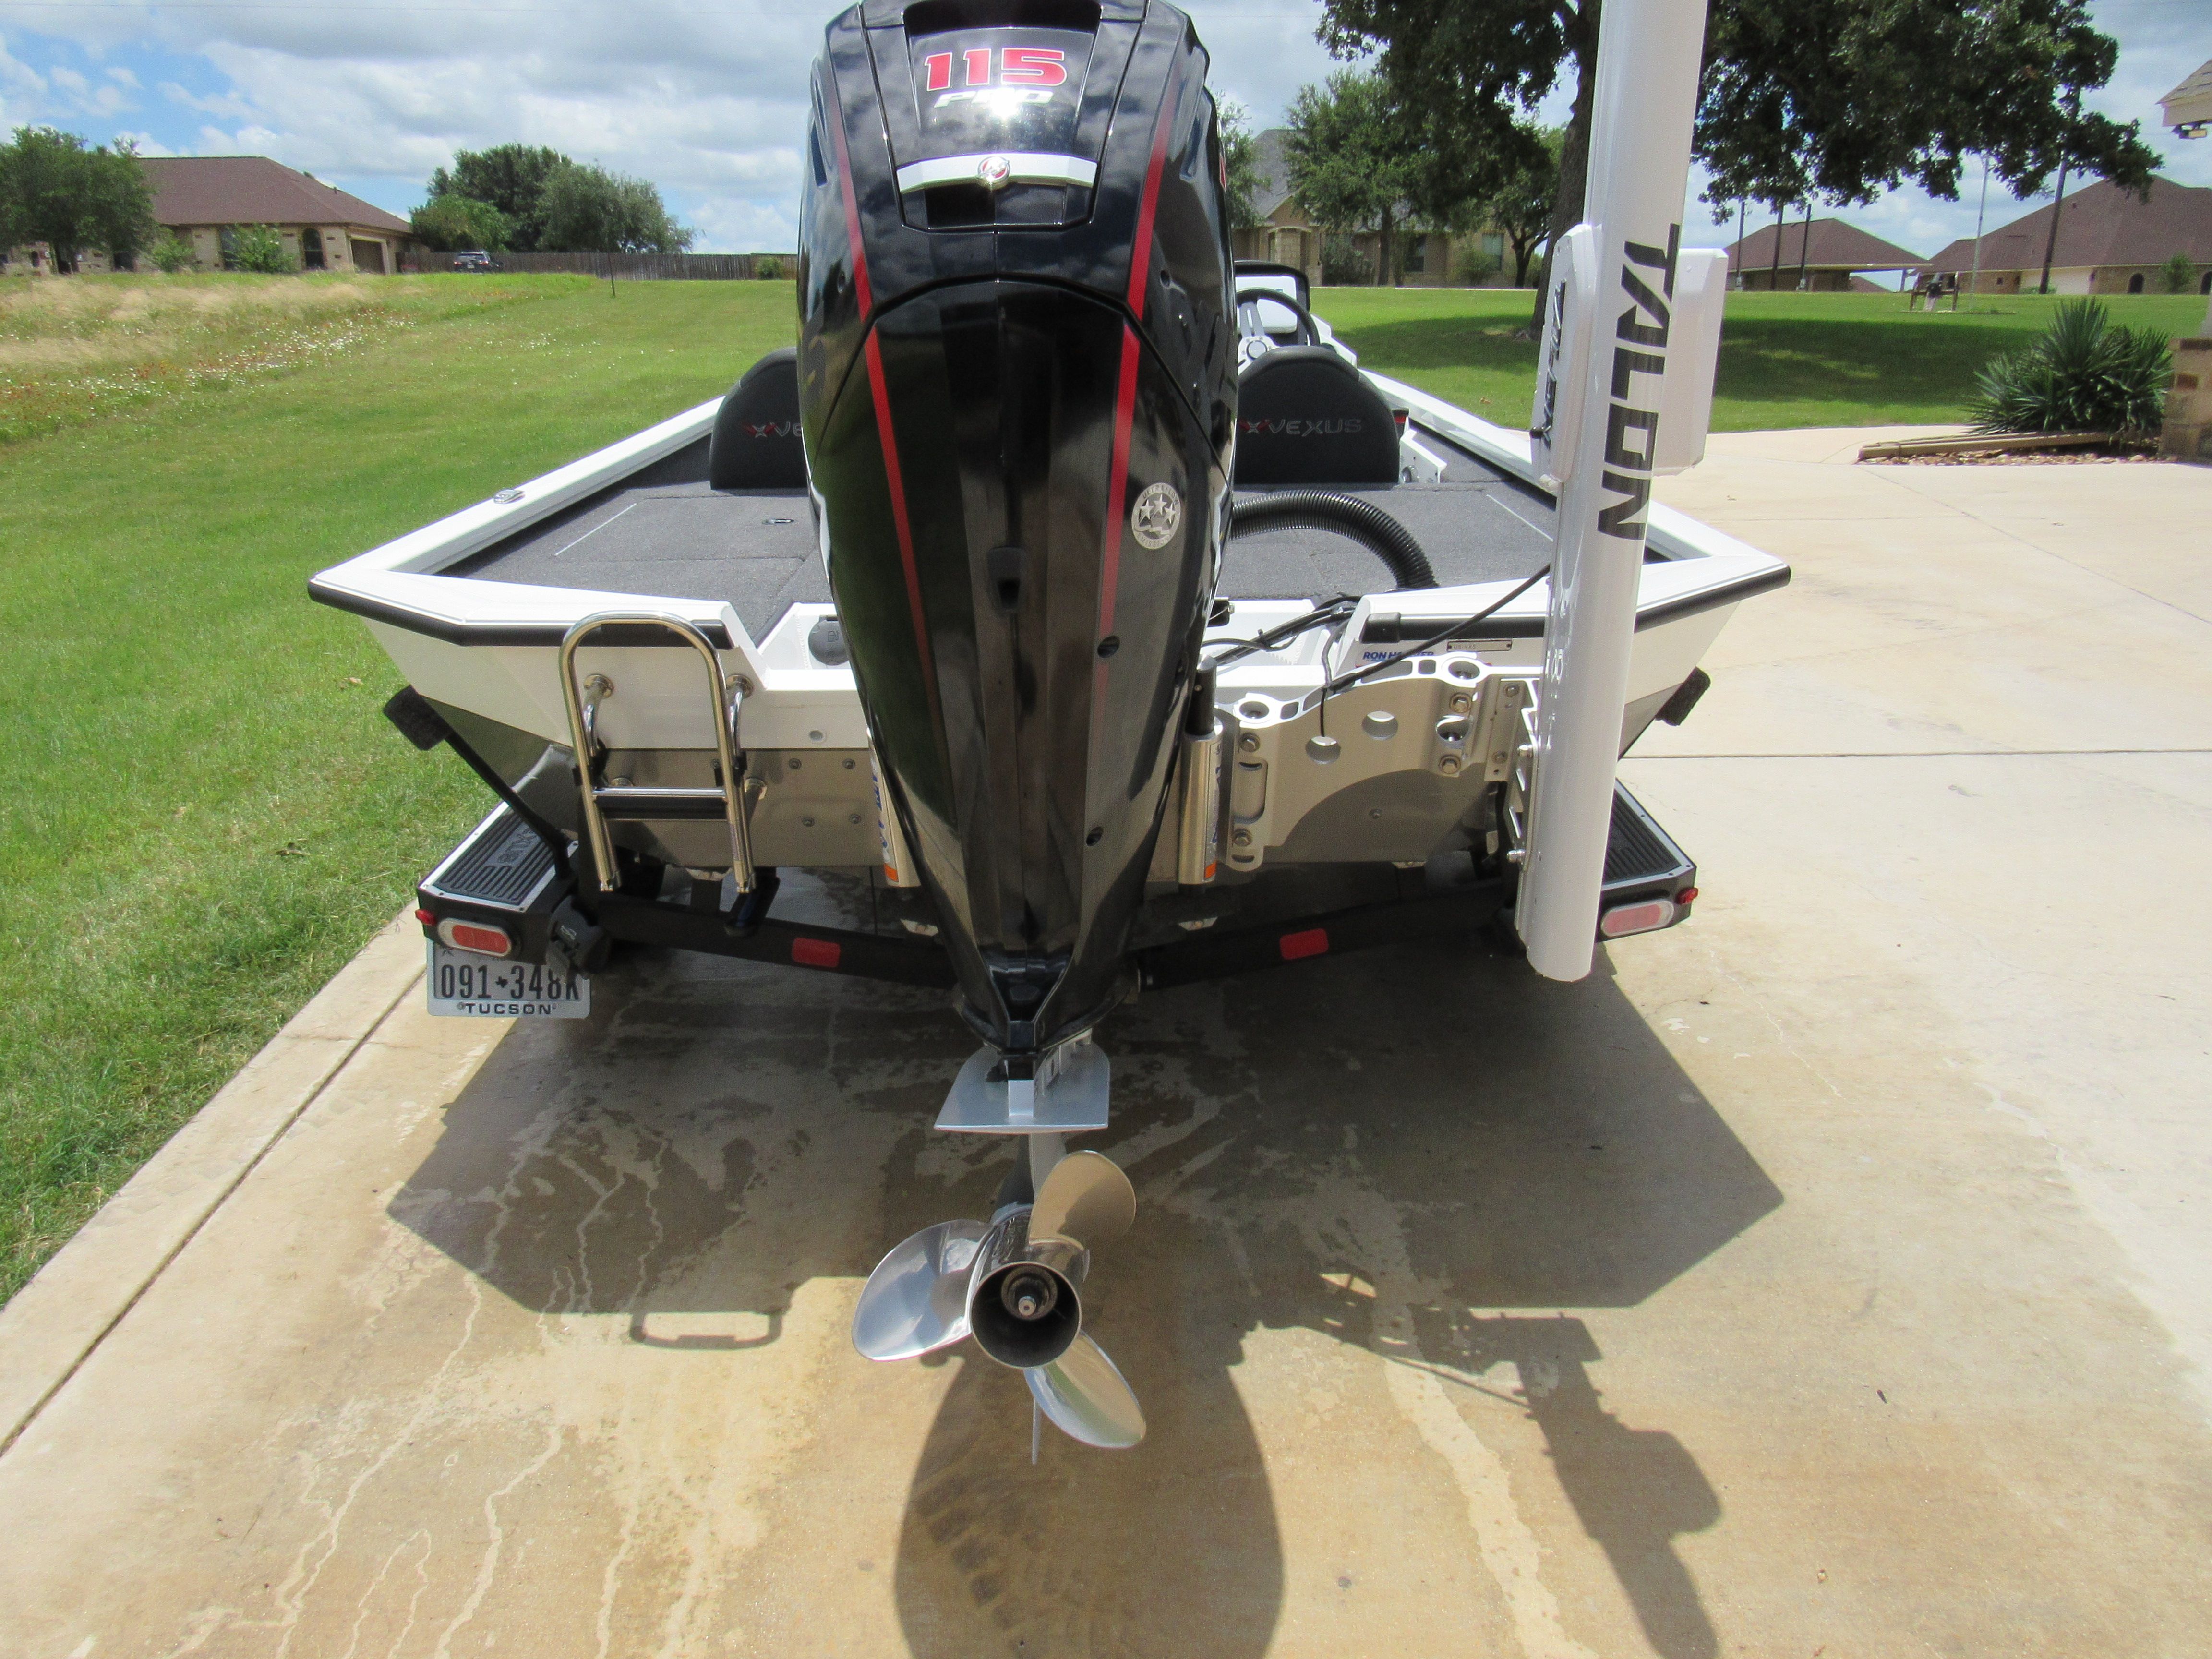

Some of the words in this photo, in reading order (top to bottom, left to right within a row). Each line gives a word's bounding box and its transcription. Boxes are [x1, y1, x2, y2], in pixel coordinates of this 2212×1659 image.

[924, 47, 1068, 91] 115
[1597, 223, 1681, 541] TALON
[1266, 419, 1362, 437] VEXUS
[1362, 651, 1387, 660] RON
[441, 964, 492, 999] 091
[465, 1003, 552, 1015] TUCSON
